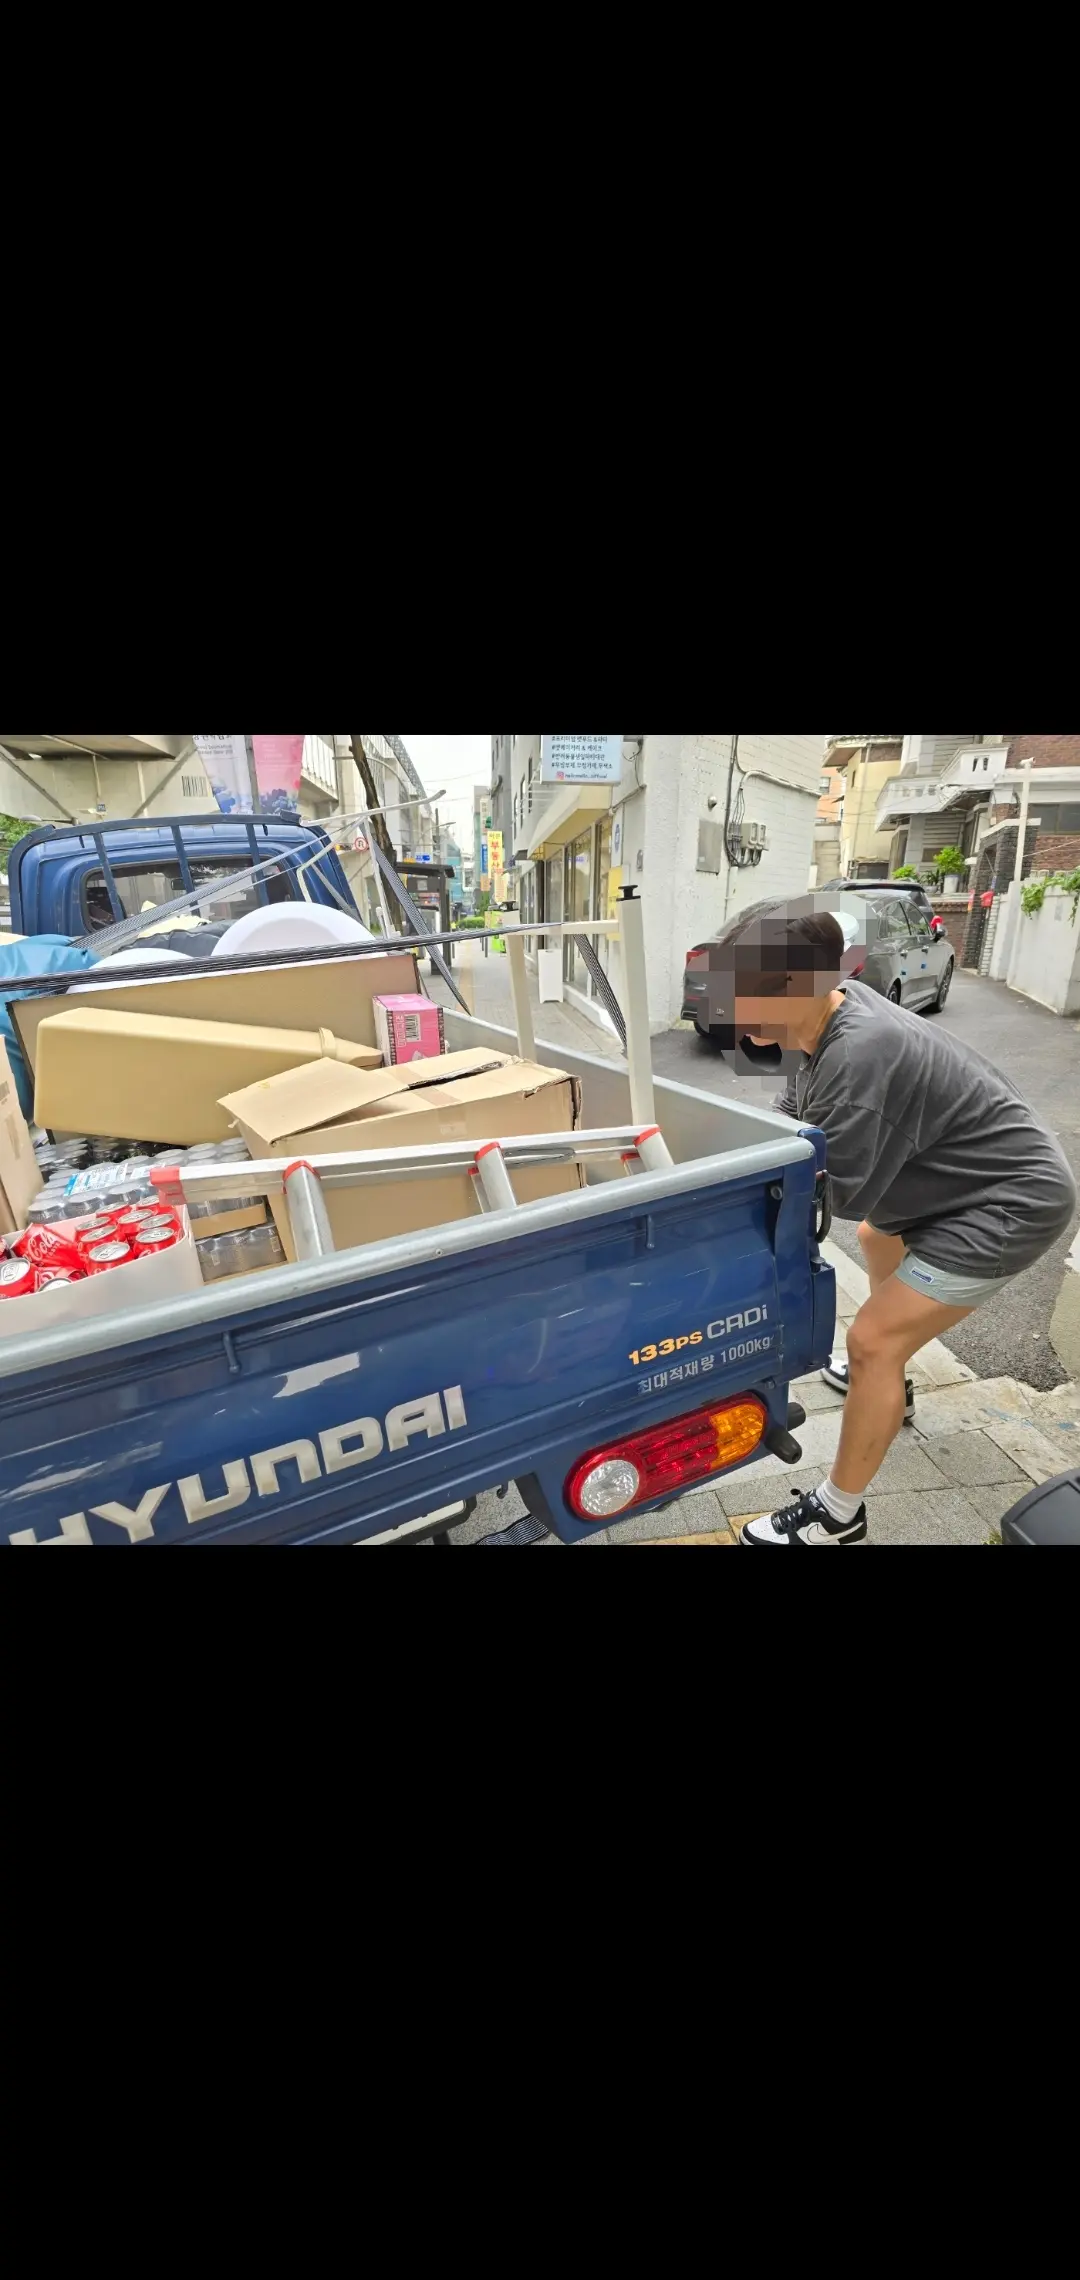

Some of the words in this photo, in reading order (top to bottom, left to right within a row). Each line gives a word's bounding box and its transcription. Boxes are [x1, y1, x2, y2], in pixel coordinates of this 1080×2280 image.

[706, 1304, 768, 1340] CRDi
[638, 1355, 715, 1394] 최대적재량
[720, 1336, 771, 1363] 1000kg
